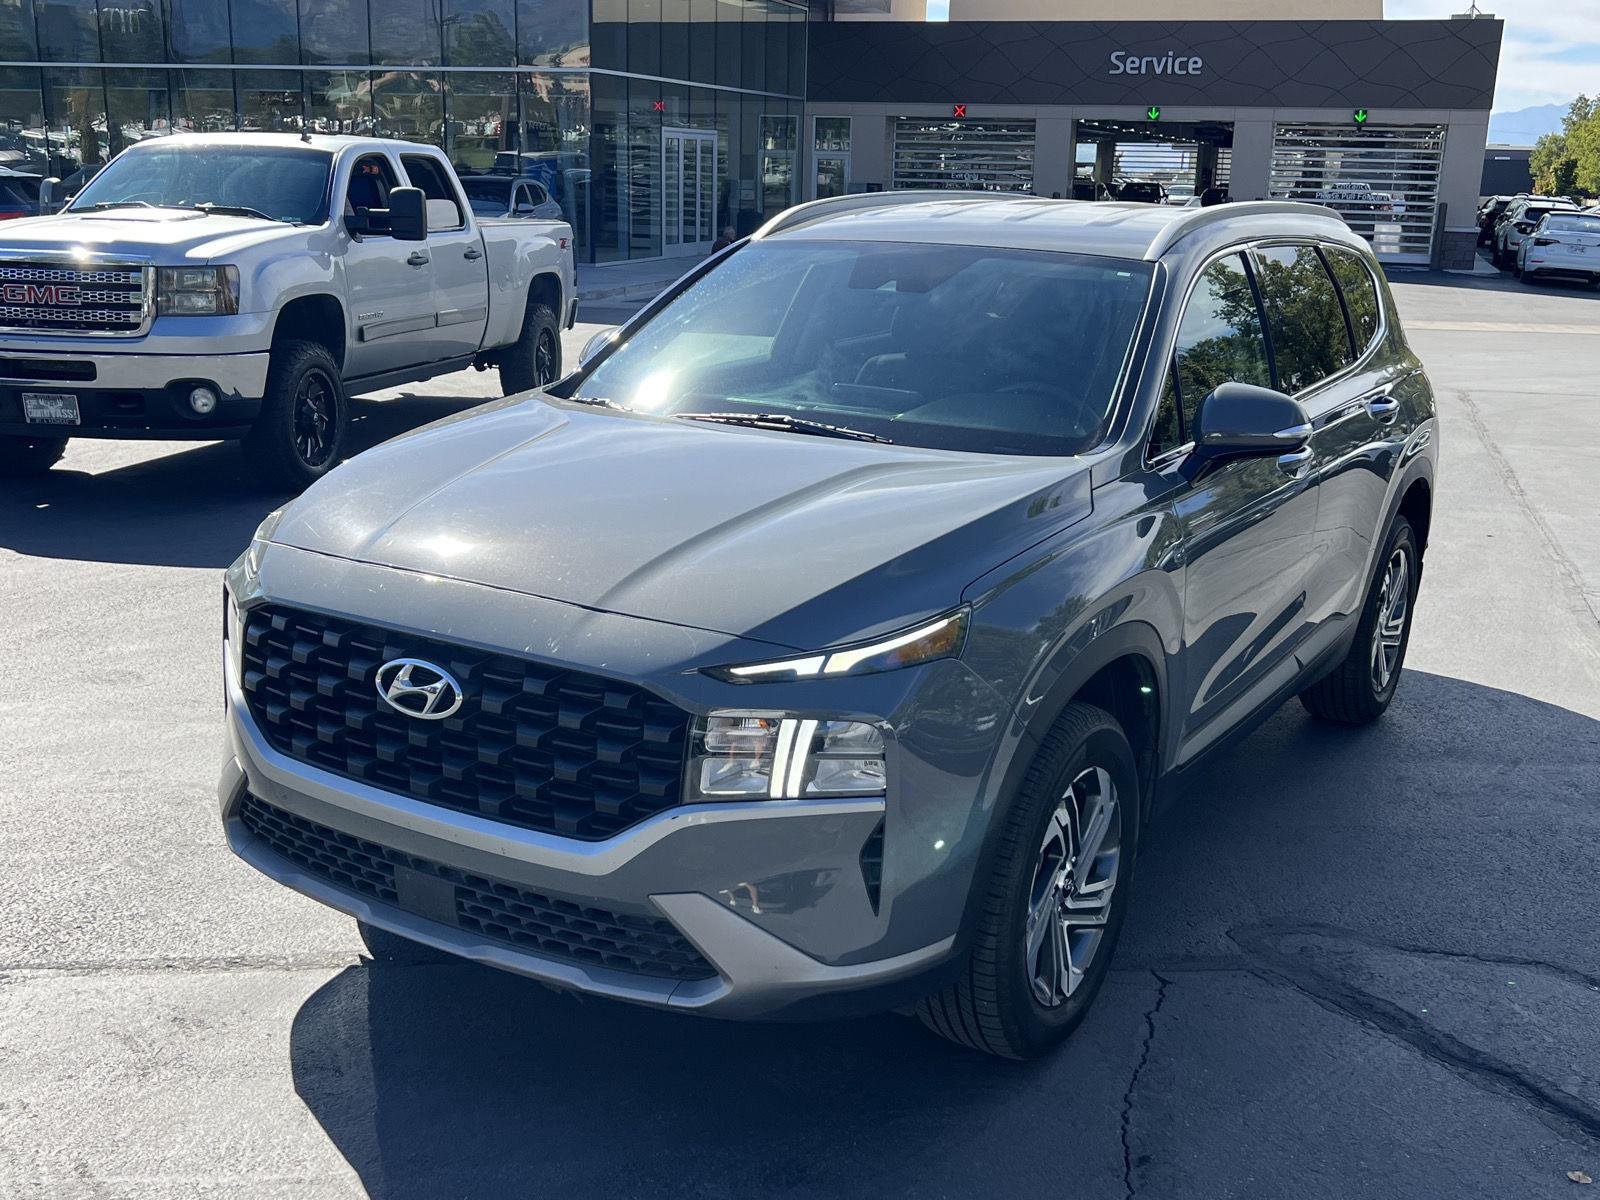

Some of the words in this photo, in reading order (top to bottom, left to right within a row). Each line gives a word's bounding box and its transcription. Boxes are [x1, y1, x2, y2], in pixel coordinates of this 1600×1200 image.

[1109, 50, 1203, 75] Service
[1315, 191, 1340, 200] Please
[1341, 192, 1356, 200] Pull
[1357, 192, 1389, 201] Forward
[3, 284, 82, 305] GMC
